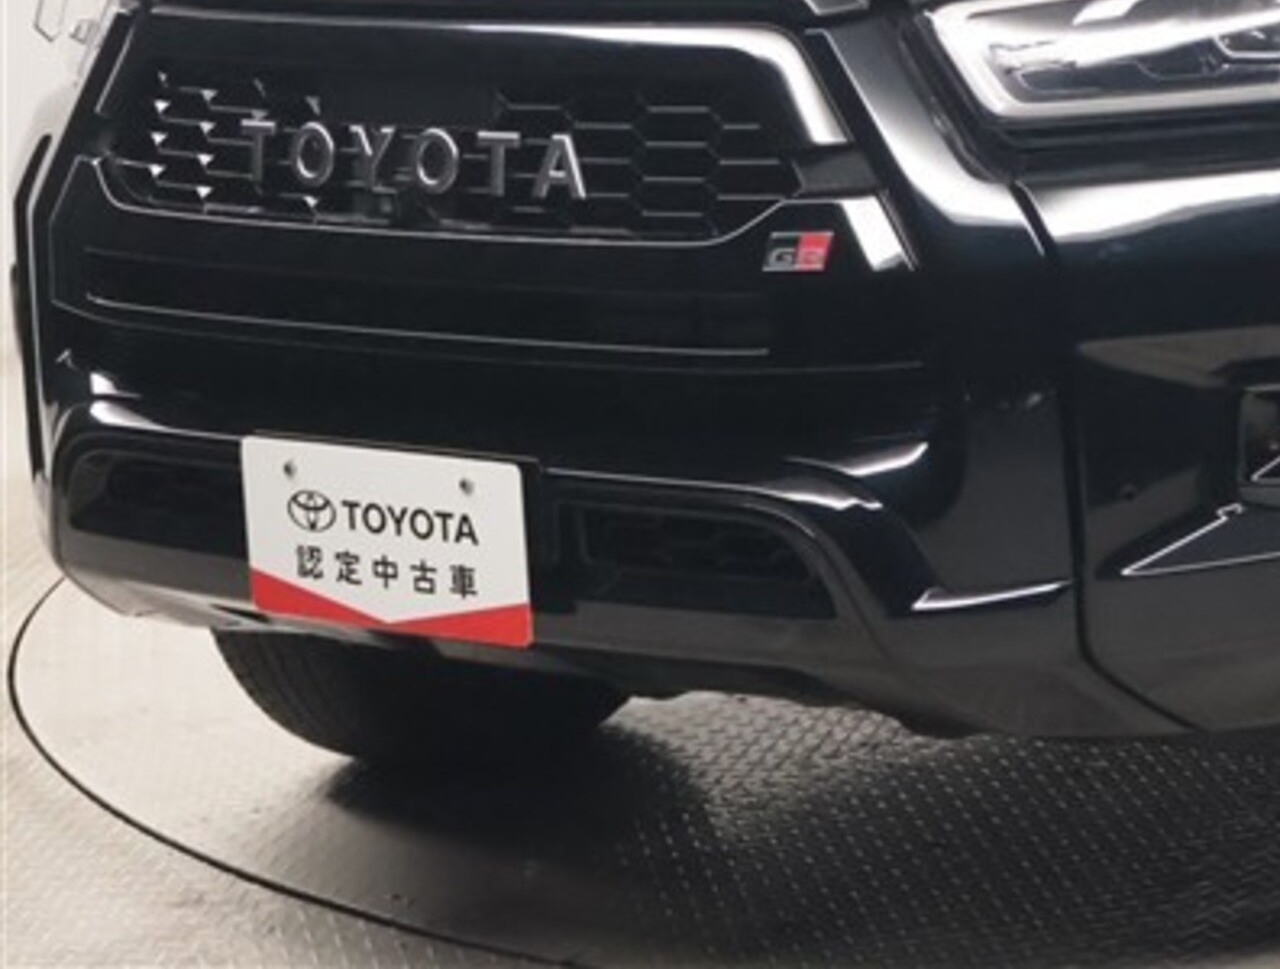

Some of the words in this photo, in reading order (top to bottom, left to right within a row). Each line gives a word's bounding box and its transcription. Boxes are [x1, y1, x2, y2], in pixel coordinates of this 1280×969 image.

[239, 118, 586, 199] TOYOTA
[341, 500, 479, 546] TOYOTA
[296, 544, 478, 599] 認定中古車
